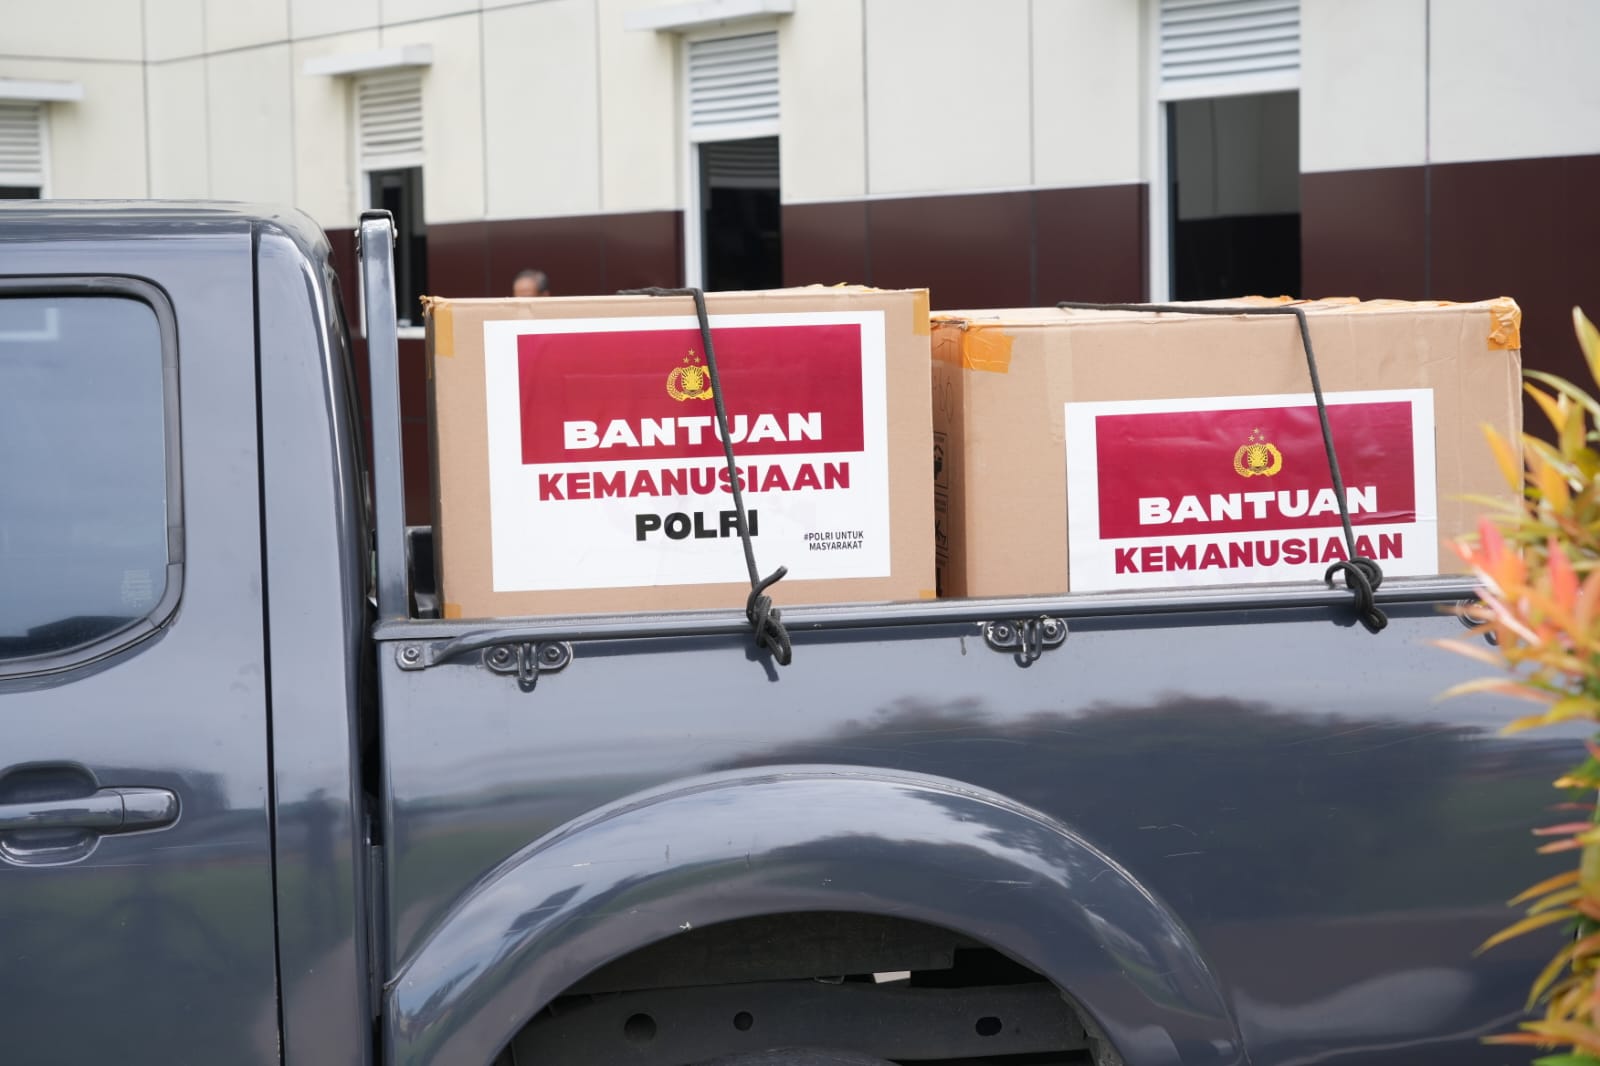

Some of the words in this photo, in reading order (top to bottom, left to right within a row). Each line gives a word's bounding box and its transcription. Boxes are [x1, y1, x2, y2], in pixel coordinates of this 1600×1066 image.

[563, 412, 822, 450] BANTUAN
[538, 462, 850, 501] KEMANUSIAAN
[1138, 486, 1378, 525] BANTUAN
[635, 509, 759, 542] POLRI
[804, 532, 833, 541] #POLRI
[835, 530, 864, 540] UNTUK
[809, 540, 863, 551] MASYARAKAT
[1115, 533, 1403, 574] KEMANUSIAAN
